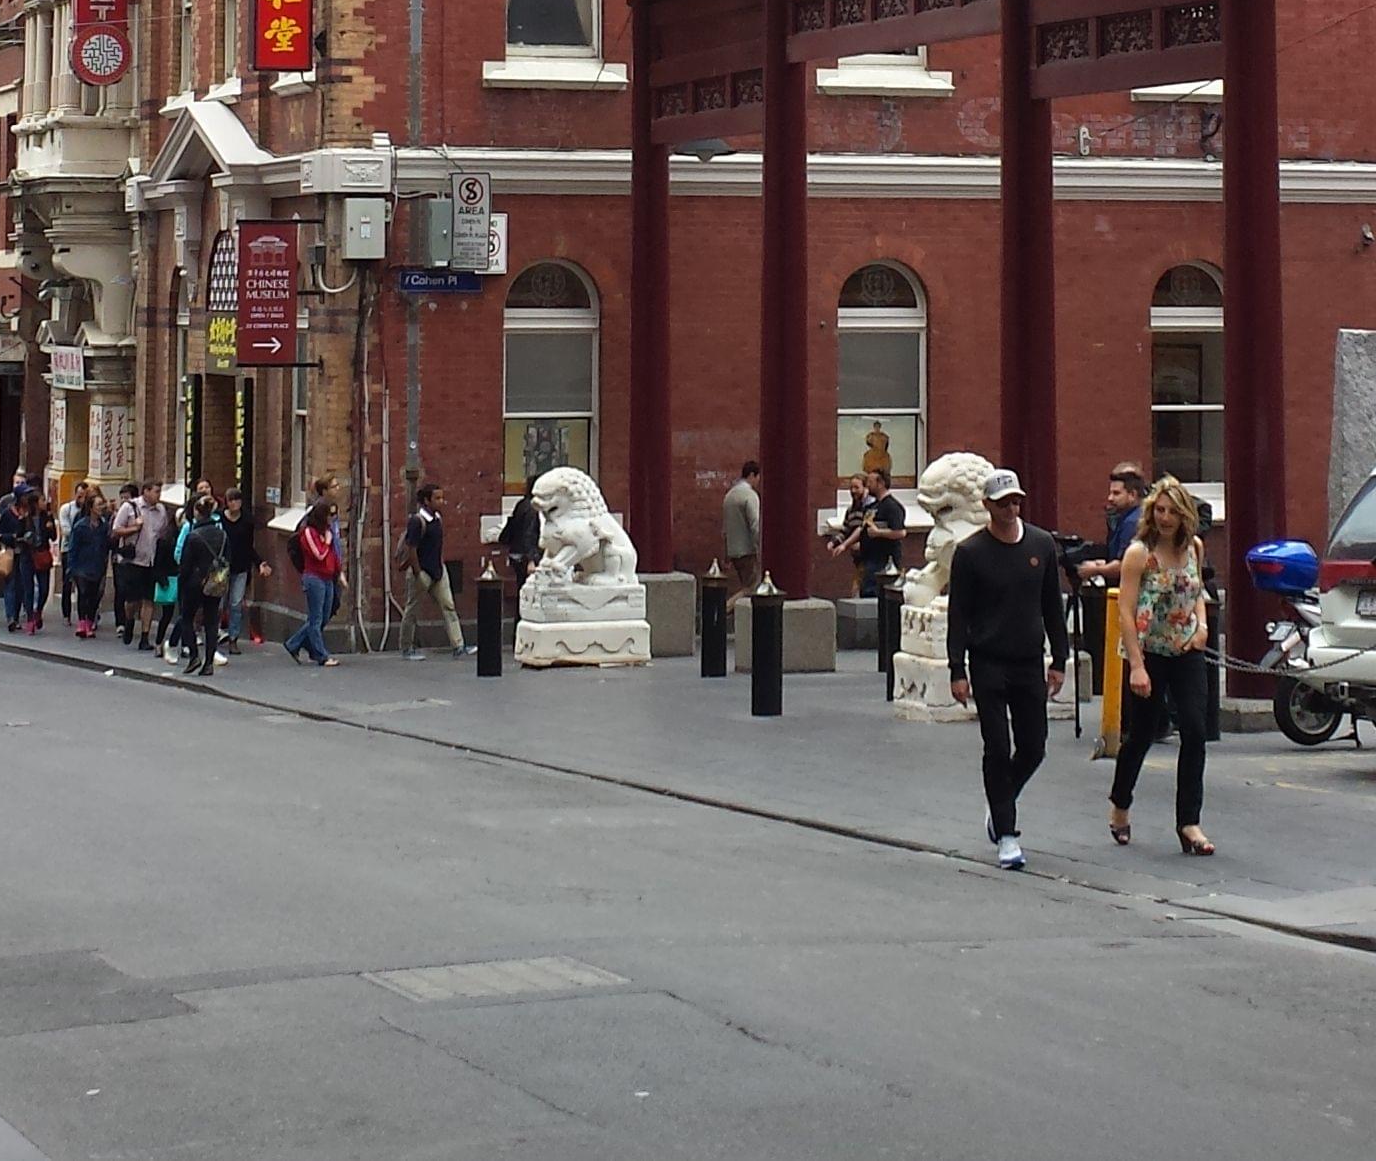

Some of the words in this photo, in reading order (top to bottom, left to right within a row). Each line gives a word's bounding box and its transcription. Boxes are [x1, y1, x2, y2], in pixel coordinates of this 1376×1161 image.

[458, 206, 485, 215] AREA
[245, 279, 290, 289] CHINESE
[410, 274, 445, 286] Cohen
[447, 275, 458, 286] Pl
[245, 289, 290, 299] MUSEUM
